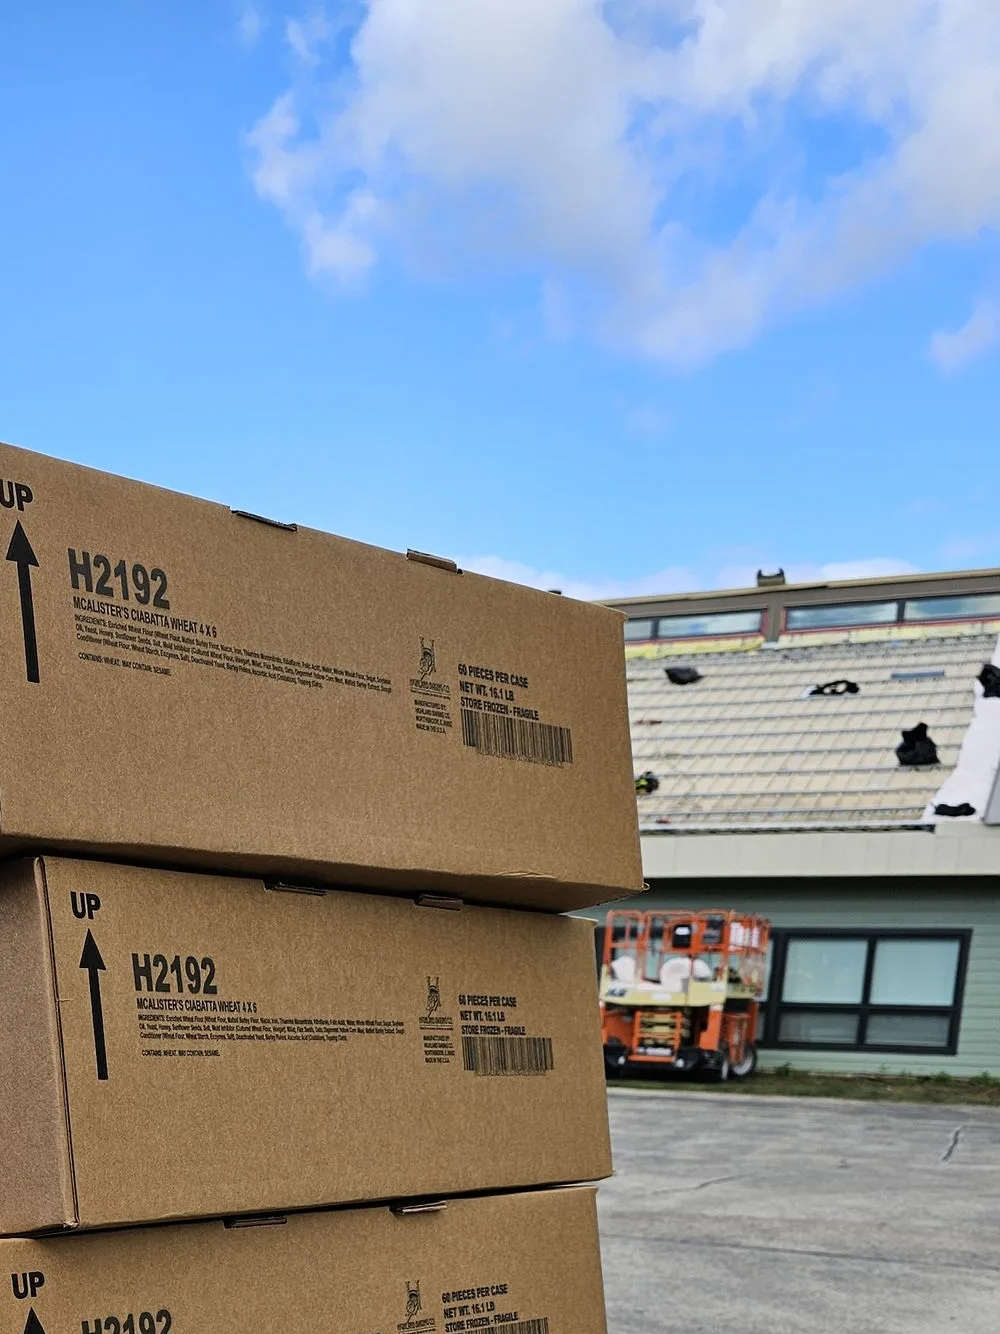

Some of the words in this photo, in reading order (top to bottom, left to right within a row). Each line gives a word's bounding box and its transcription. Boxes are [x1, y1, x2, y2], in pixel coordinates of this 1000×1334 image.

[67, 547, 170, 610] H2192
[73, 597, 129, 619] MCALISTER'S
[131, 609, 170, 628] CIABATTA
[170, 618, 198, 634] WHEAT
[205, 625, 212, 637] X
[212, 626, 217, 638] 6
[458, 664, 468, 676] 60
[468, 666, 494, 681] PIECES
[495, 671, 509, 684] PER
[510, 674, 528, 689] CASE
[459, 680, 474, 694] NET
[475, 684, 488, 697] WT.
[489, 687, 503, 700] 16.1
[504, 689, 514, 702] LB
[460, 696, 482, 710] STORE
[483, 701, 508, 715] FROZEN
[513, 707, 539, 721] FRAGILE
[70, 891, 100, 919] UP
[131, 952, 218, 995] H2192
[11, 1271, 45, 1299] UP
[442, 1292, 451, 1304] 60
[452, 1289, 476, 1302] PIECES
[476, 1286, 490, 1298] PER
[490, 1284, 508, 1296] CASE
[443, 1307, 457, 1319] NET
[458, 1305, 470, 1316] WT.
[471, 1303, 485, 1314] 16.1
[486, 1301, 495, 1312] LB
[445, 1320, 466, 1333] STORE
[466, 1316, 490, 1329] FROZEN
[494, 1311, 518, 1324] FRAGILE
